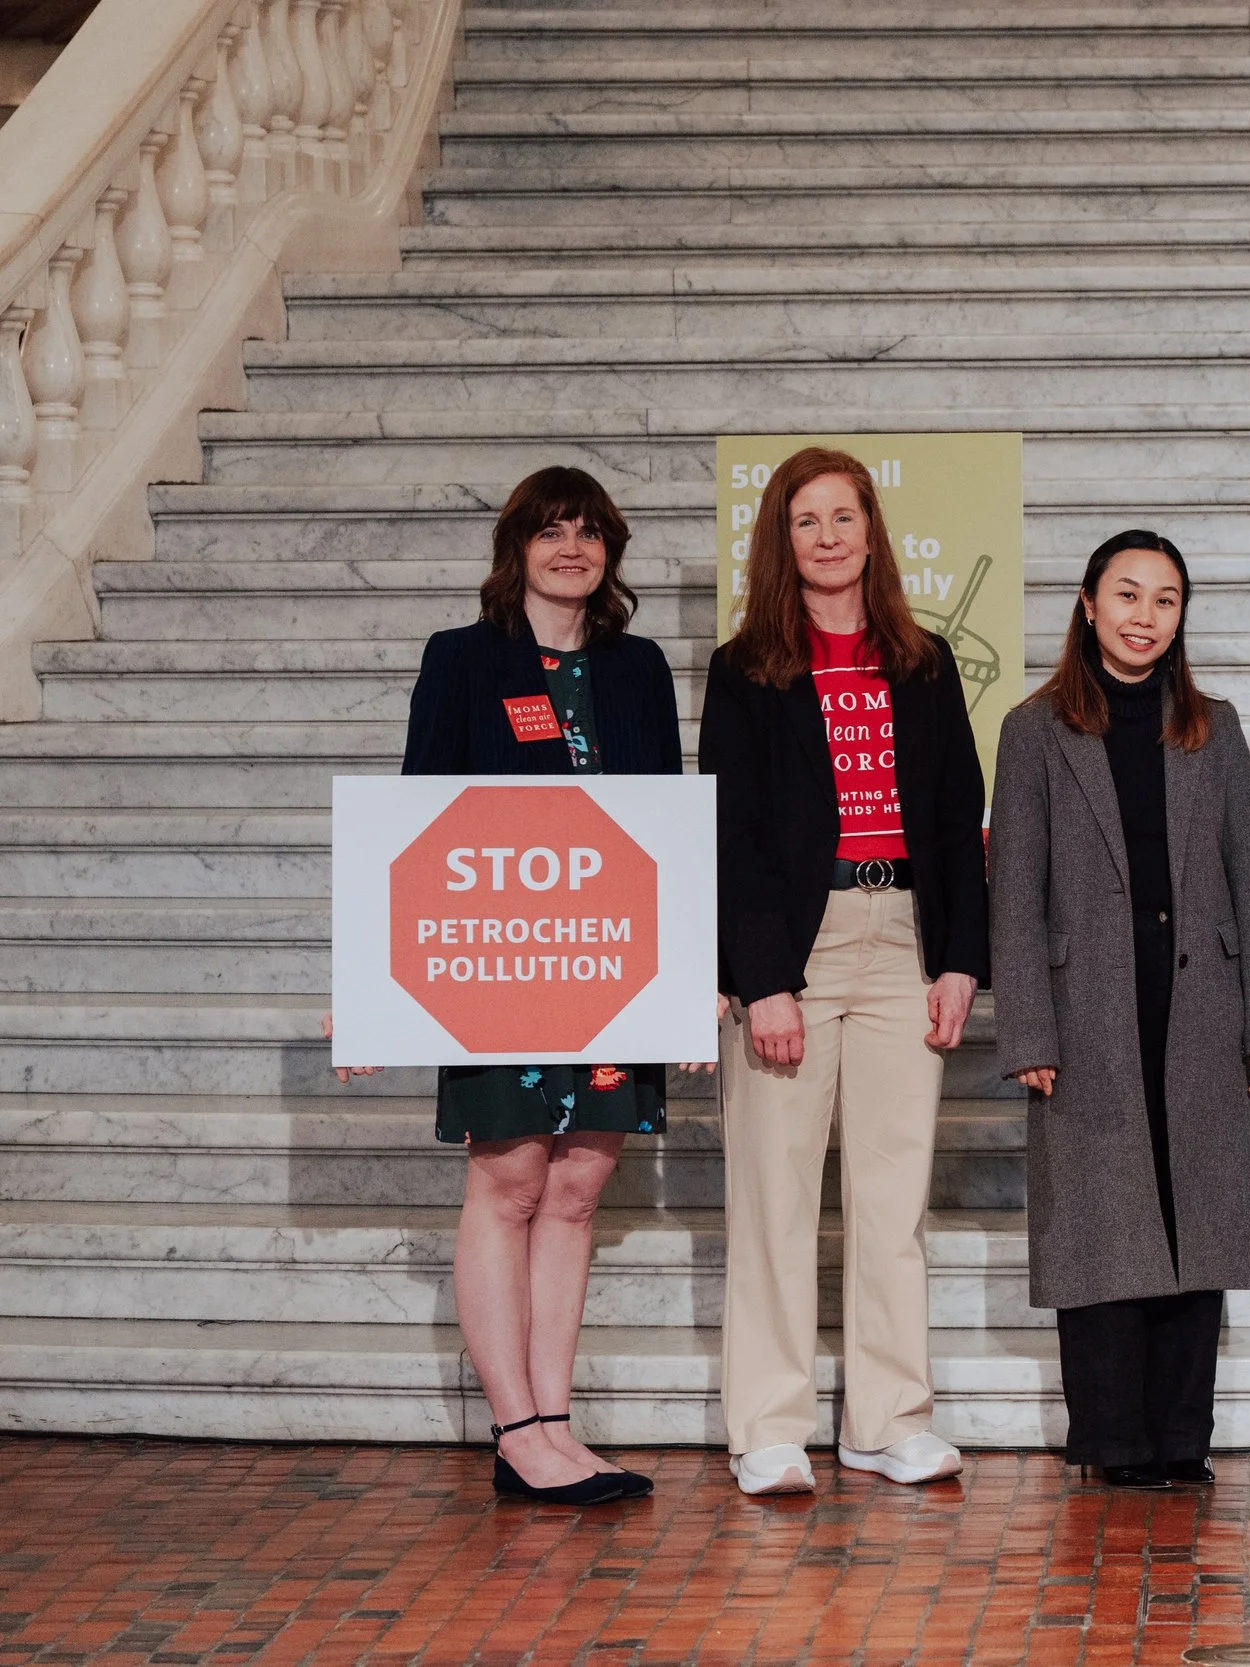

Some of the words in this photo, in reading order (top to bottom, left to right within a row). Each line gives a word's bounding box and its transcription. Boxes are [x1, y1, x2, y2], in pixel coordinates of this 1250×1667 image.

[731, 463, 779, 489] 50
[902, 532, 940, 560] to
[902, 567, 954, 601] nly
[513, 704, 547, 714] MOMS
[821, 690, 890, 712] MOM
[516, 715, 537, 724] clean
[538, 713, 551, 721] air
[519, 723, 555, 733] FORCE
[824, 717, 871, 742] lean
[834, 749, 895, 772] ORC
[840, 790, 883, 802] HTING
[446, 846, 603, 891] STOP
[417, 917, 631, 944] PETROCHEM
[427, 955, 622, 982] POLLUTION
